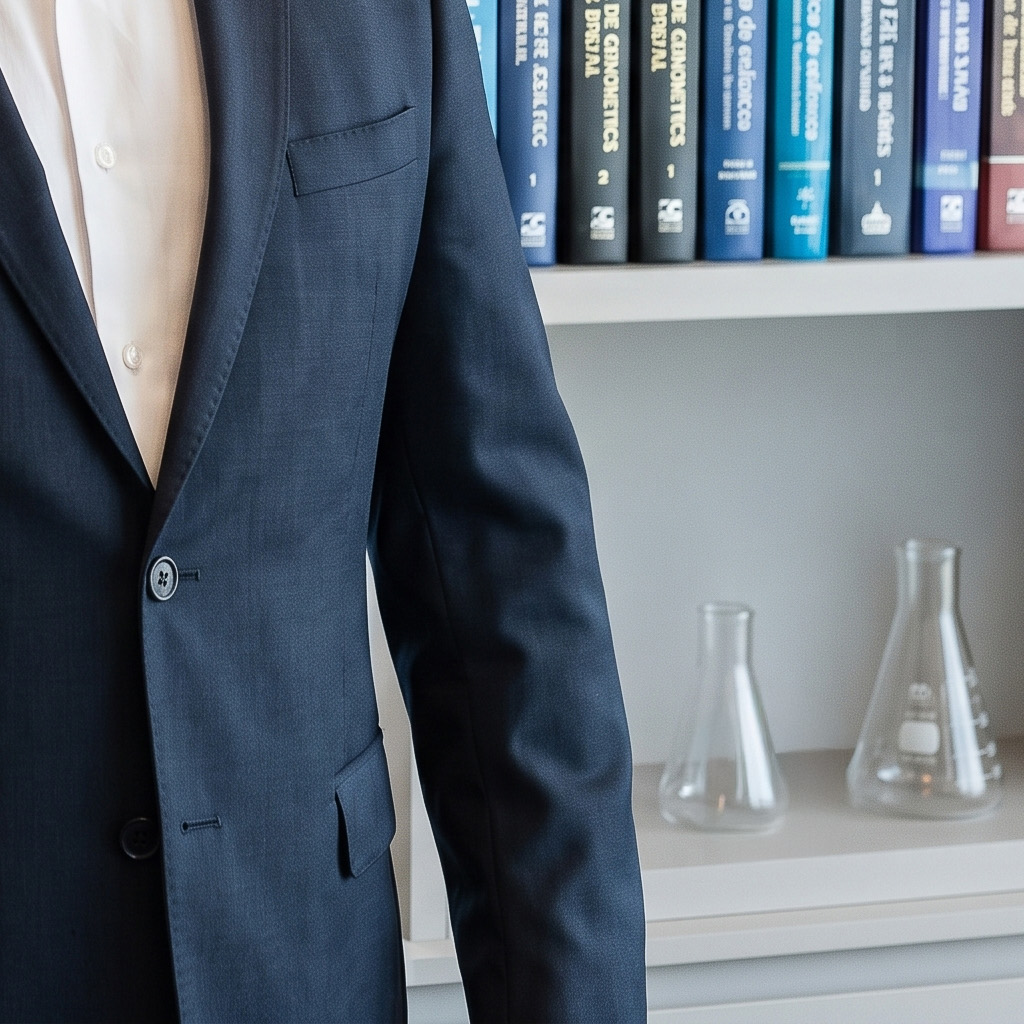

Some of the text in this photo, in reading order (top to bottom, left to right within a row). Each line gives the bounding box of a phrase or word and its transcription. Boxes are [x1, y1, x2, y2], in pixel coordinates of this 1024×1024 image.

[603, 3, 621, 29] DE
[597, 169, 610, 185] 2
[666, 163, 675, 179] 1
